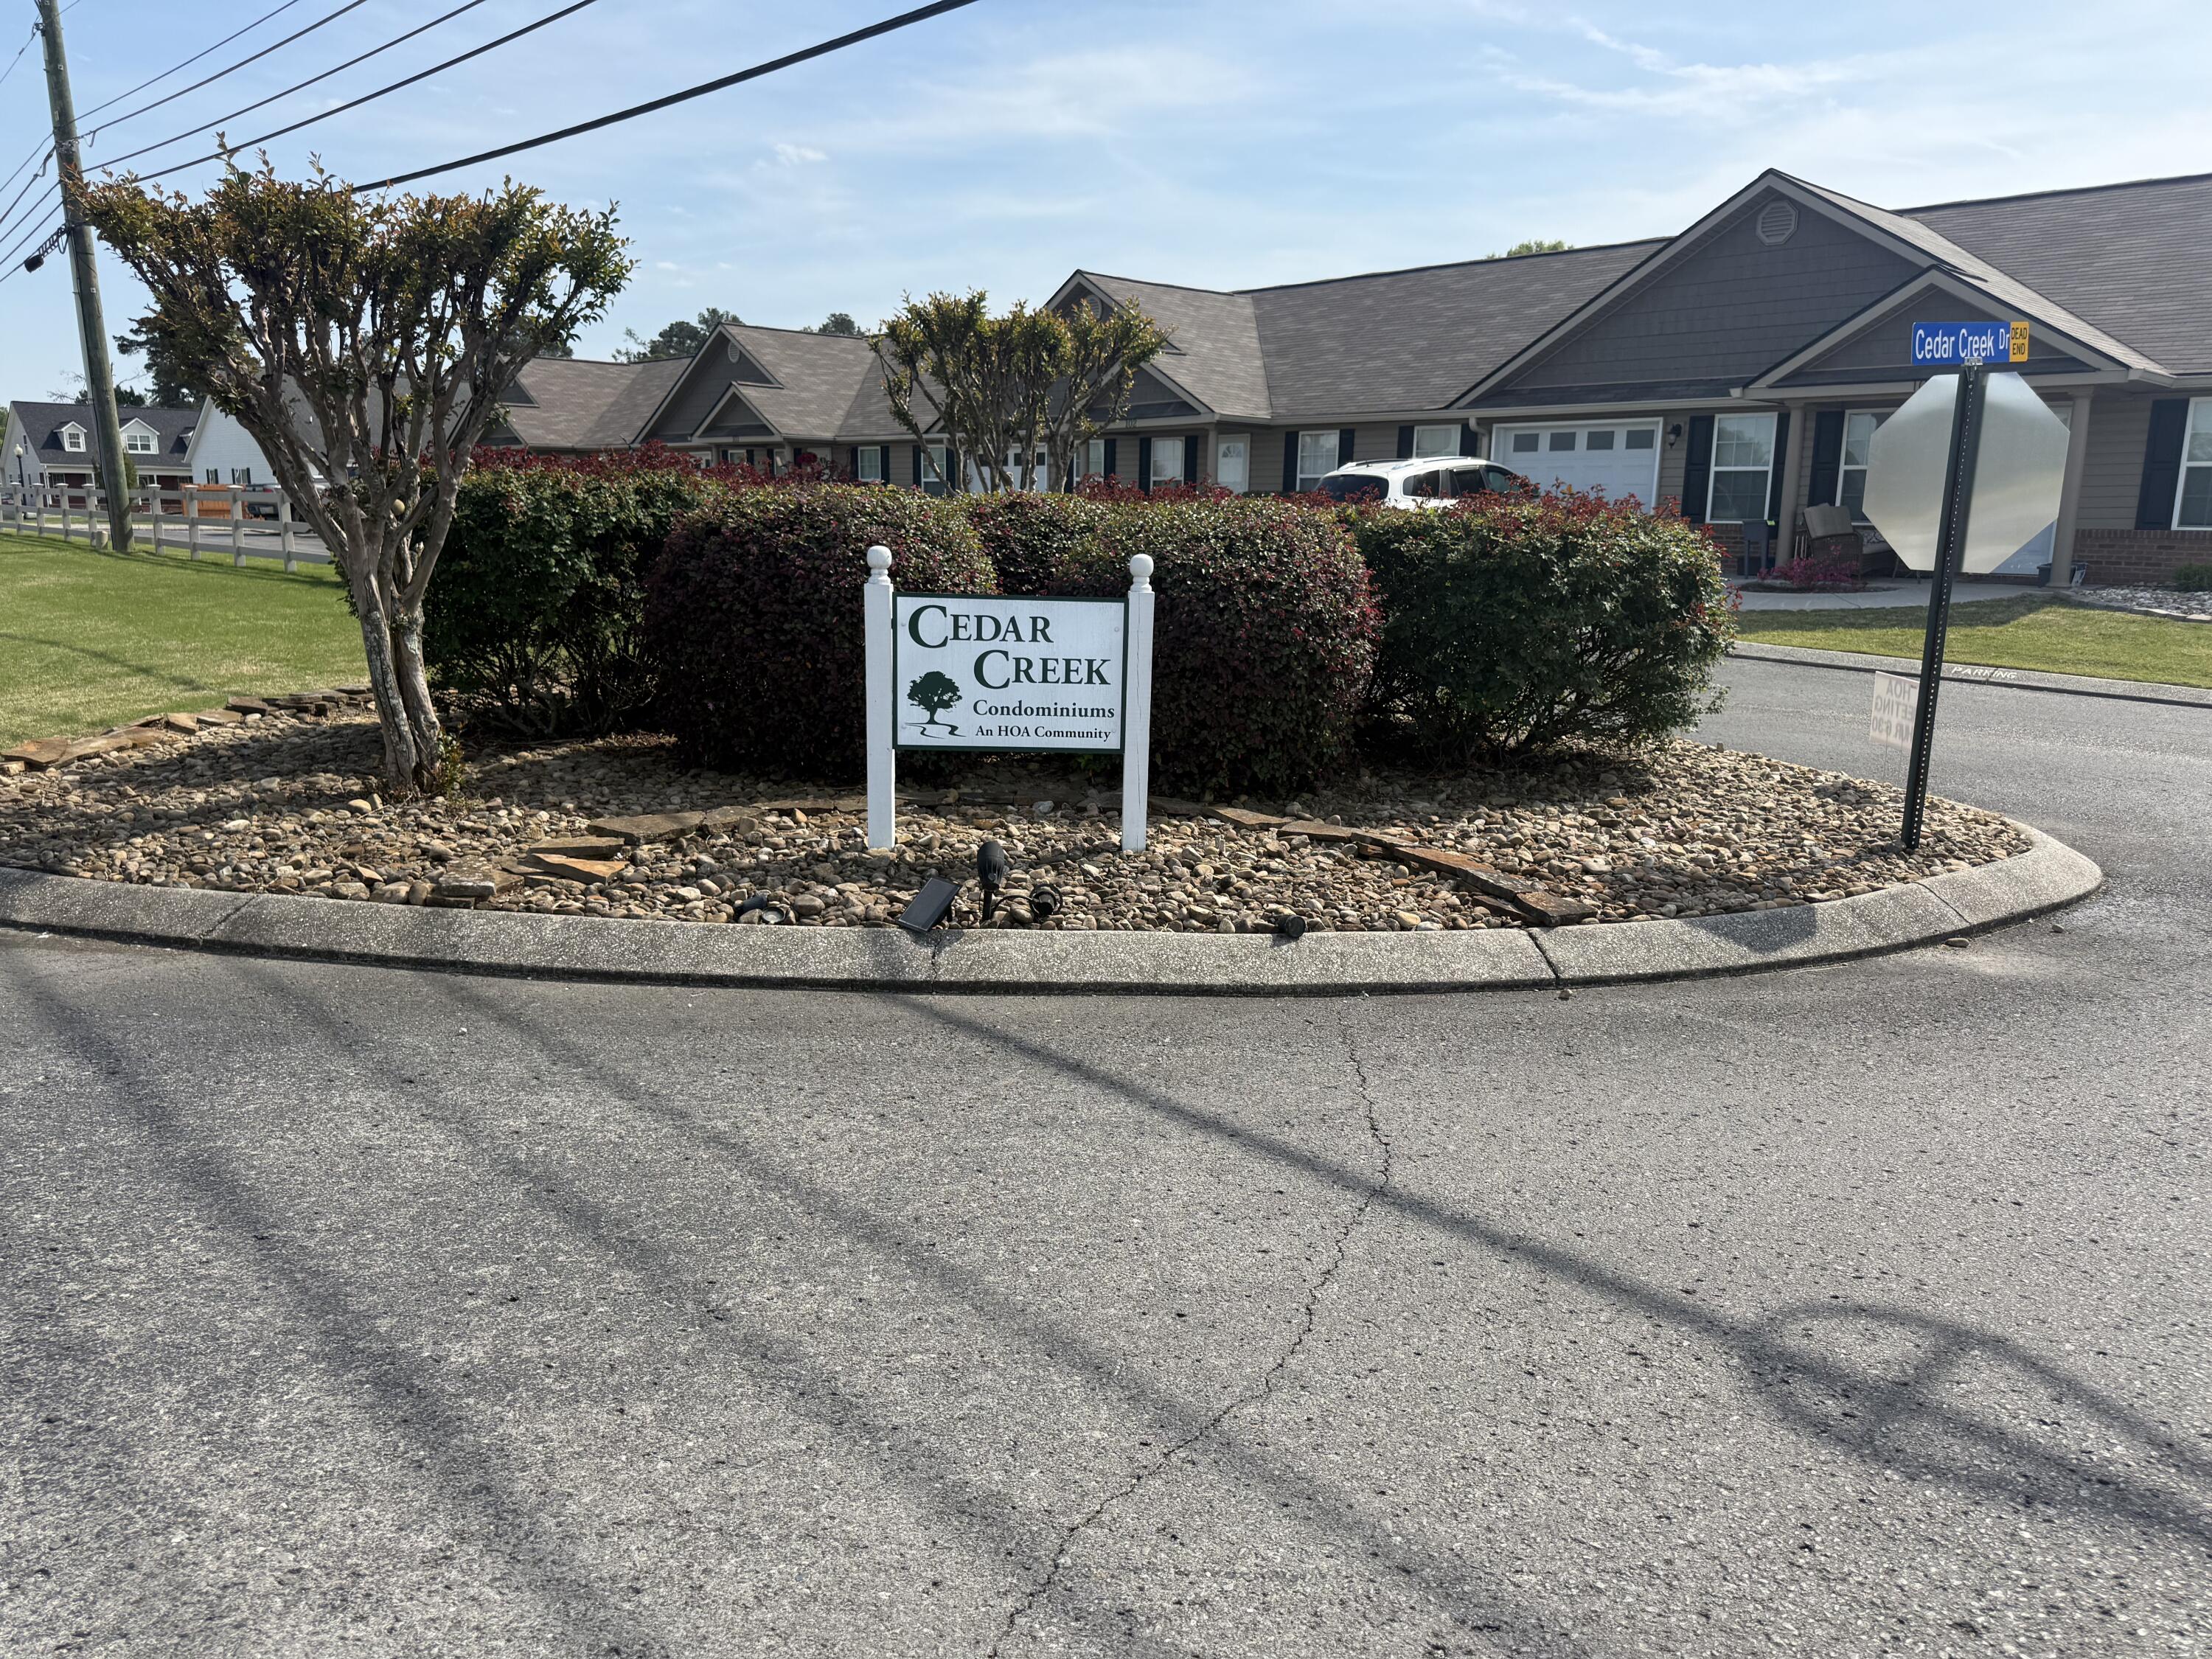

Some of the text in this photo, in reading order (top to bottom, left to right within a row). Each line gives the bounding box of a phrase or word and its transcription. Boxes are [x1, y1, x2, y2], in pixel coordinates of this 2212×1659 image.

[2011, 327, 2027, 341] DEAD
[1915, 328, 2009, 360] Cedar Creek Dr
[2012, 343, 2025, 355] END
[908, 605, 1054, 649] CEDAR
[973, 650, 1112, 689] CREEK
[1951, 666, 2017, 680] PARKING
[973, 700, 1115, 719] Condominiums
[975, 726, 1111, 742] An HOA Community
